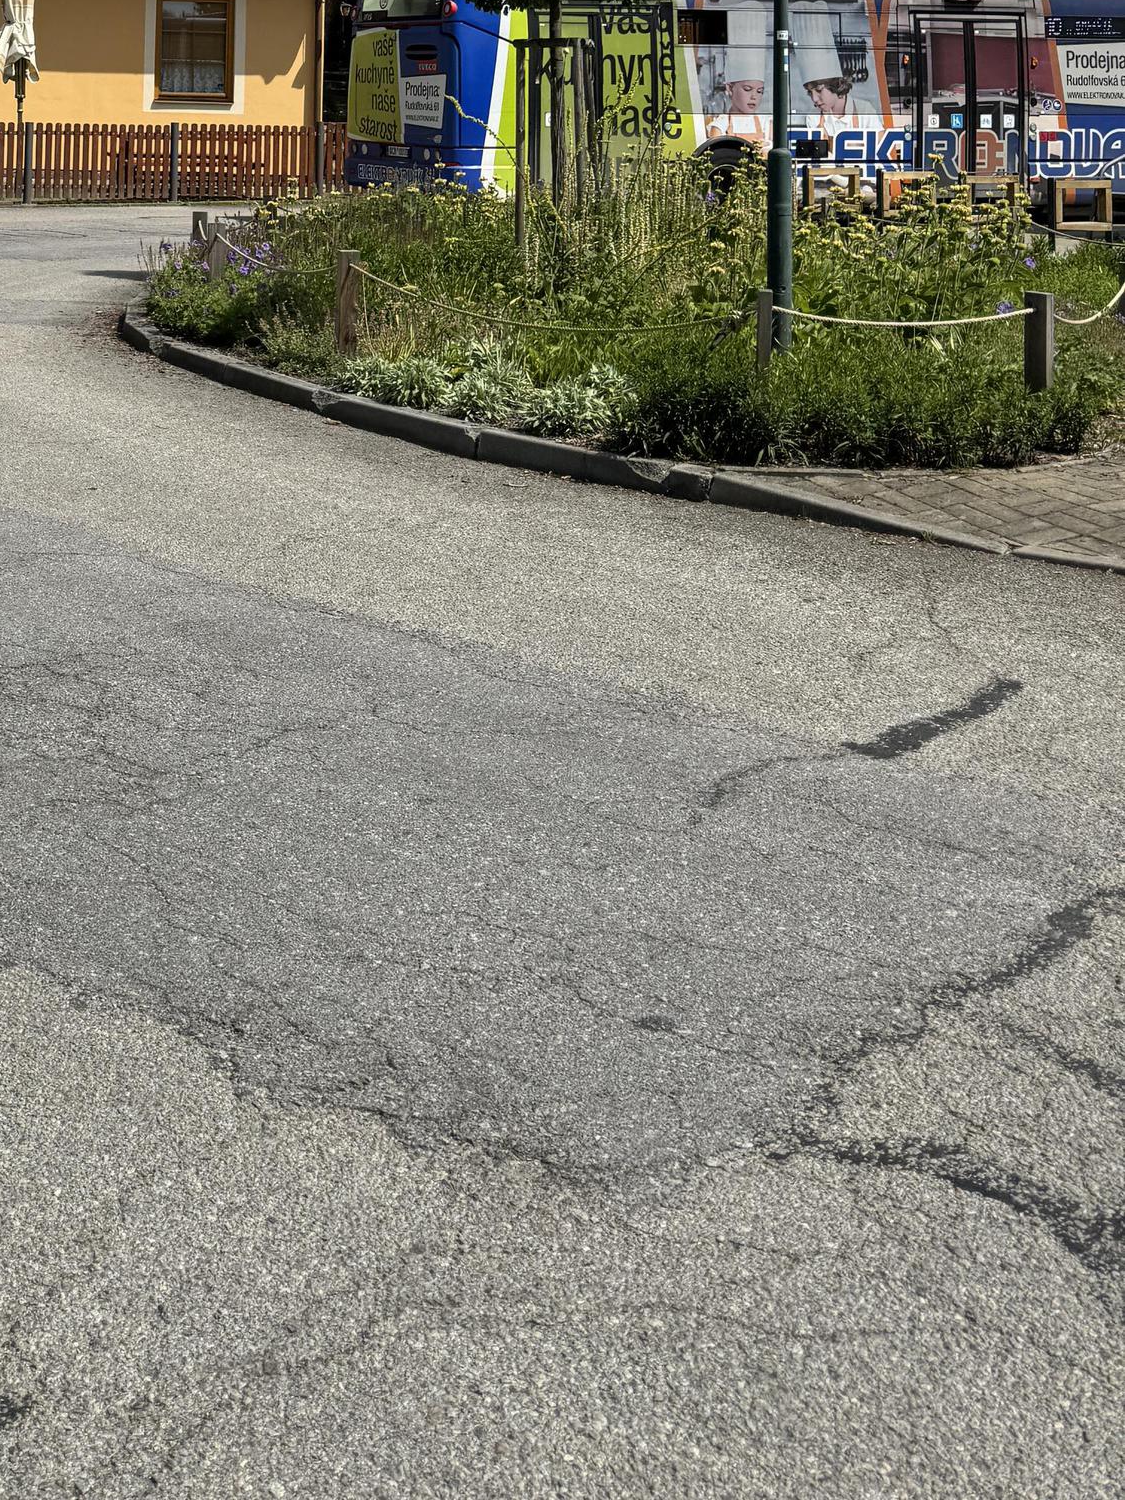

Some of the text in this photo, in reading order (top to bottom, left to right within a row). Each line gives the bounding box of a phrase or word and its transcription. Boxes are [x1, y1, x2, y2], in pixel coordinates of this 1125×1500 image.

[372, 34, 394, 57] vaše
[355, 61, 395, 88] kuchyně
[1066, 74, 1119, 86] Rudolfovská
[371, 89, 396, 113] naše
[359, 117, 398, 143] starost
